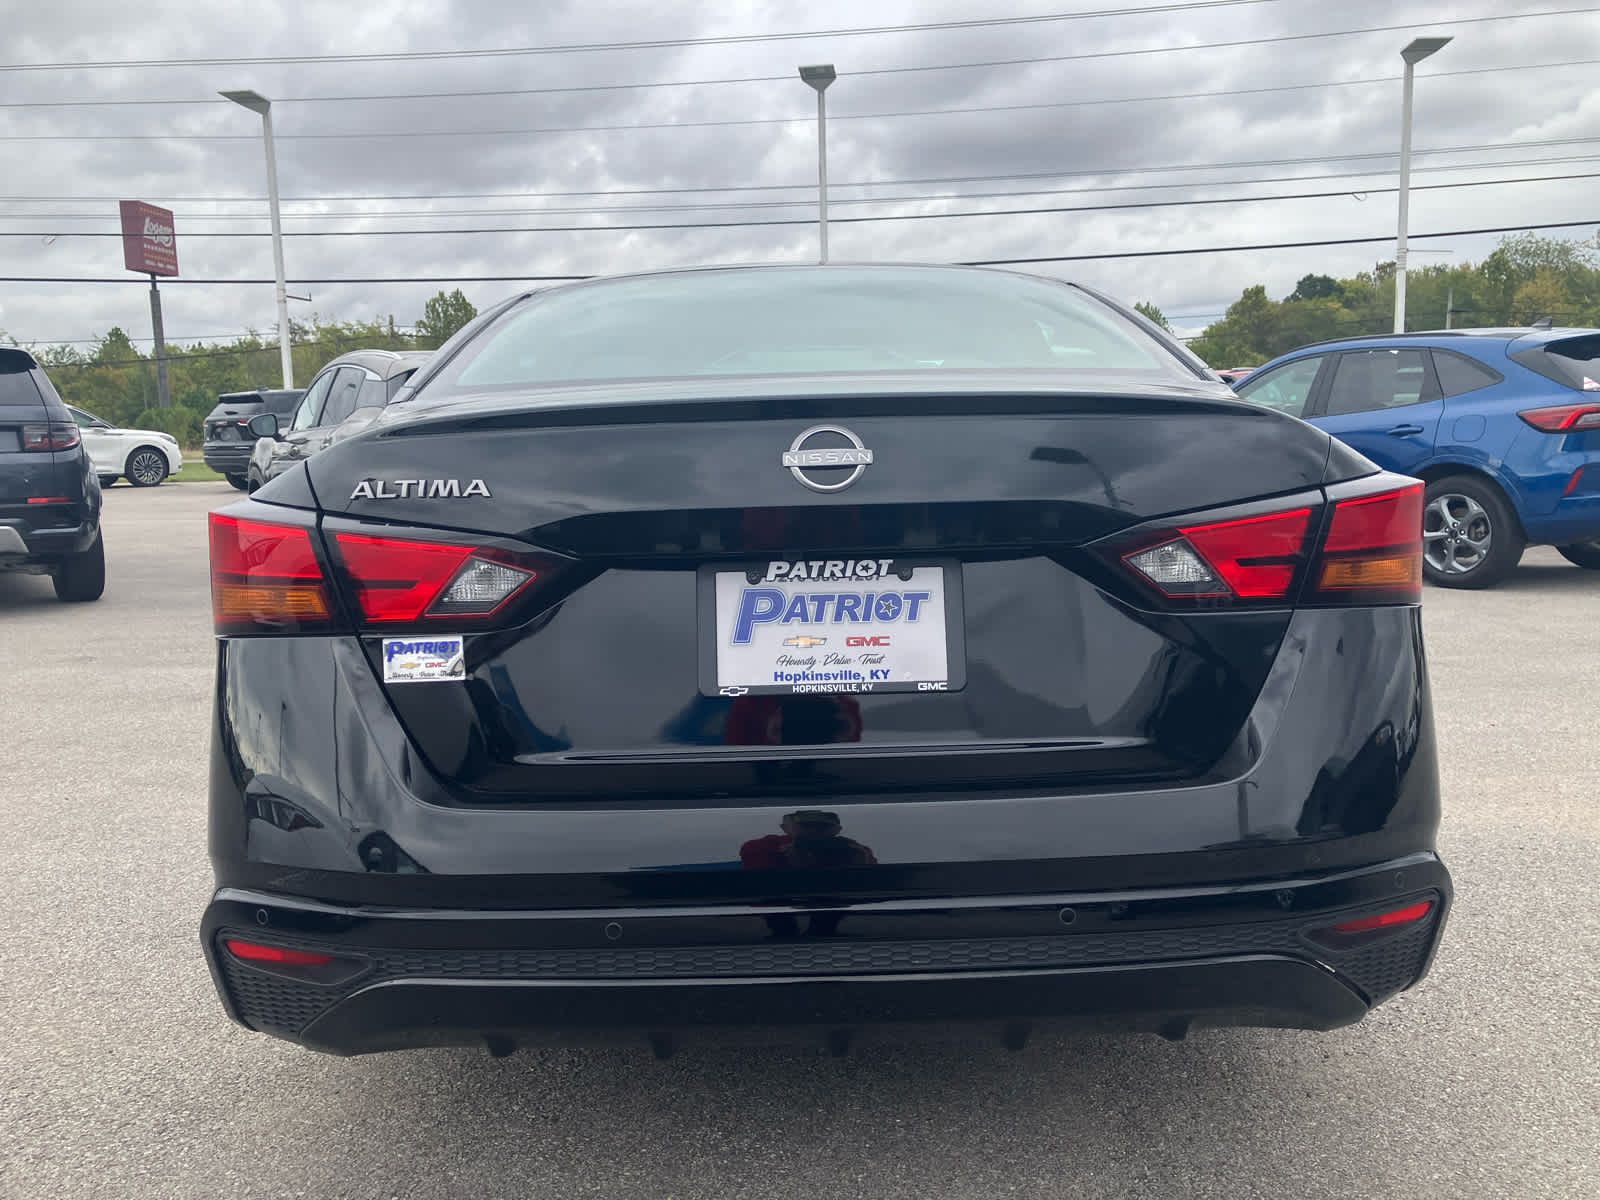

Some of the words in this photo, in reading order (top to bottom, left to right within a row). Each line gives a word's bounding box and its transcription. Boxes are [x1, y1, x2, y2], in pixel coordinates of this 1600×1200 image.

[785, 452, 870, 464] NISSAN
[350, 479, 491, 499] ALTIMA
[766, 559, 893, 581] PATRIOT
[733, 588, 930, 644] PATRIOT
[846, 636, 890, 647] GMC
[387, 641, 460, 662] PATRIOT
[776, 654, 816, 670] Honesty
[823, 652, 851, 665] Value
[858, 653, 886, 664] Trust
[773, 670, 865, 683] Hopkinsville,
[870, 669, 890, 680] KY
[792, 683, 860, 693] HOPKINSVILLE,
[862, 683, 873, 691] KY
[917, 682, 948, 691] GMC
